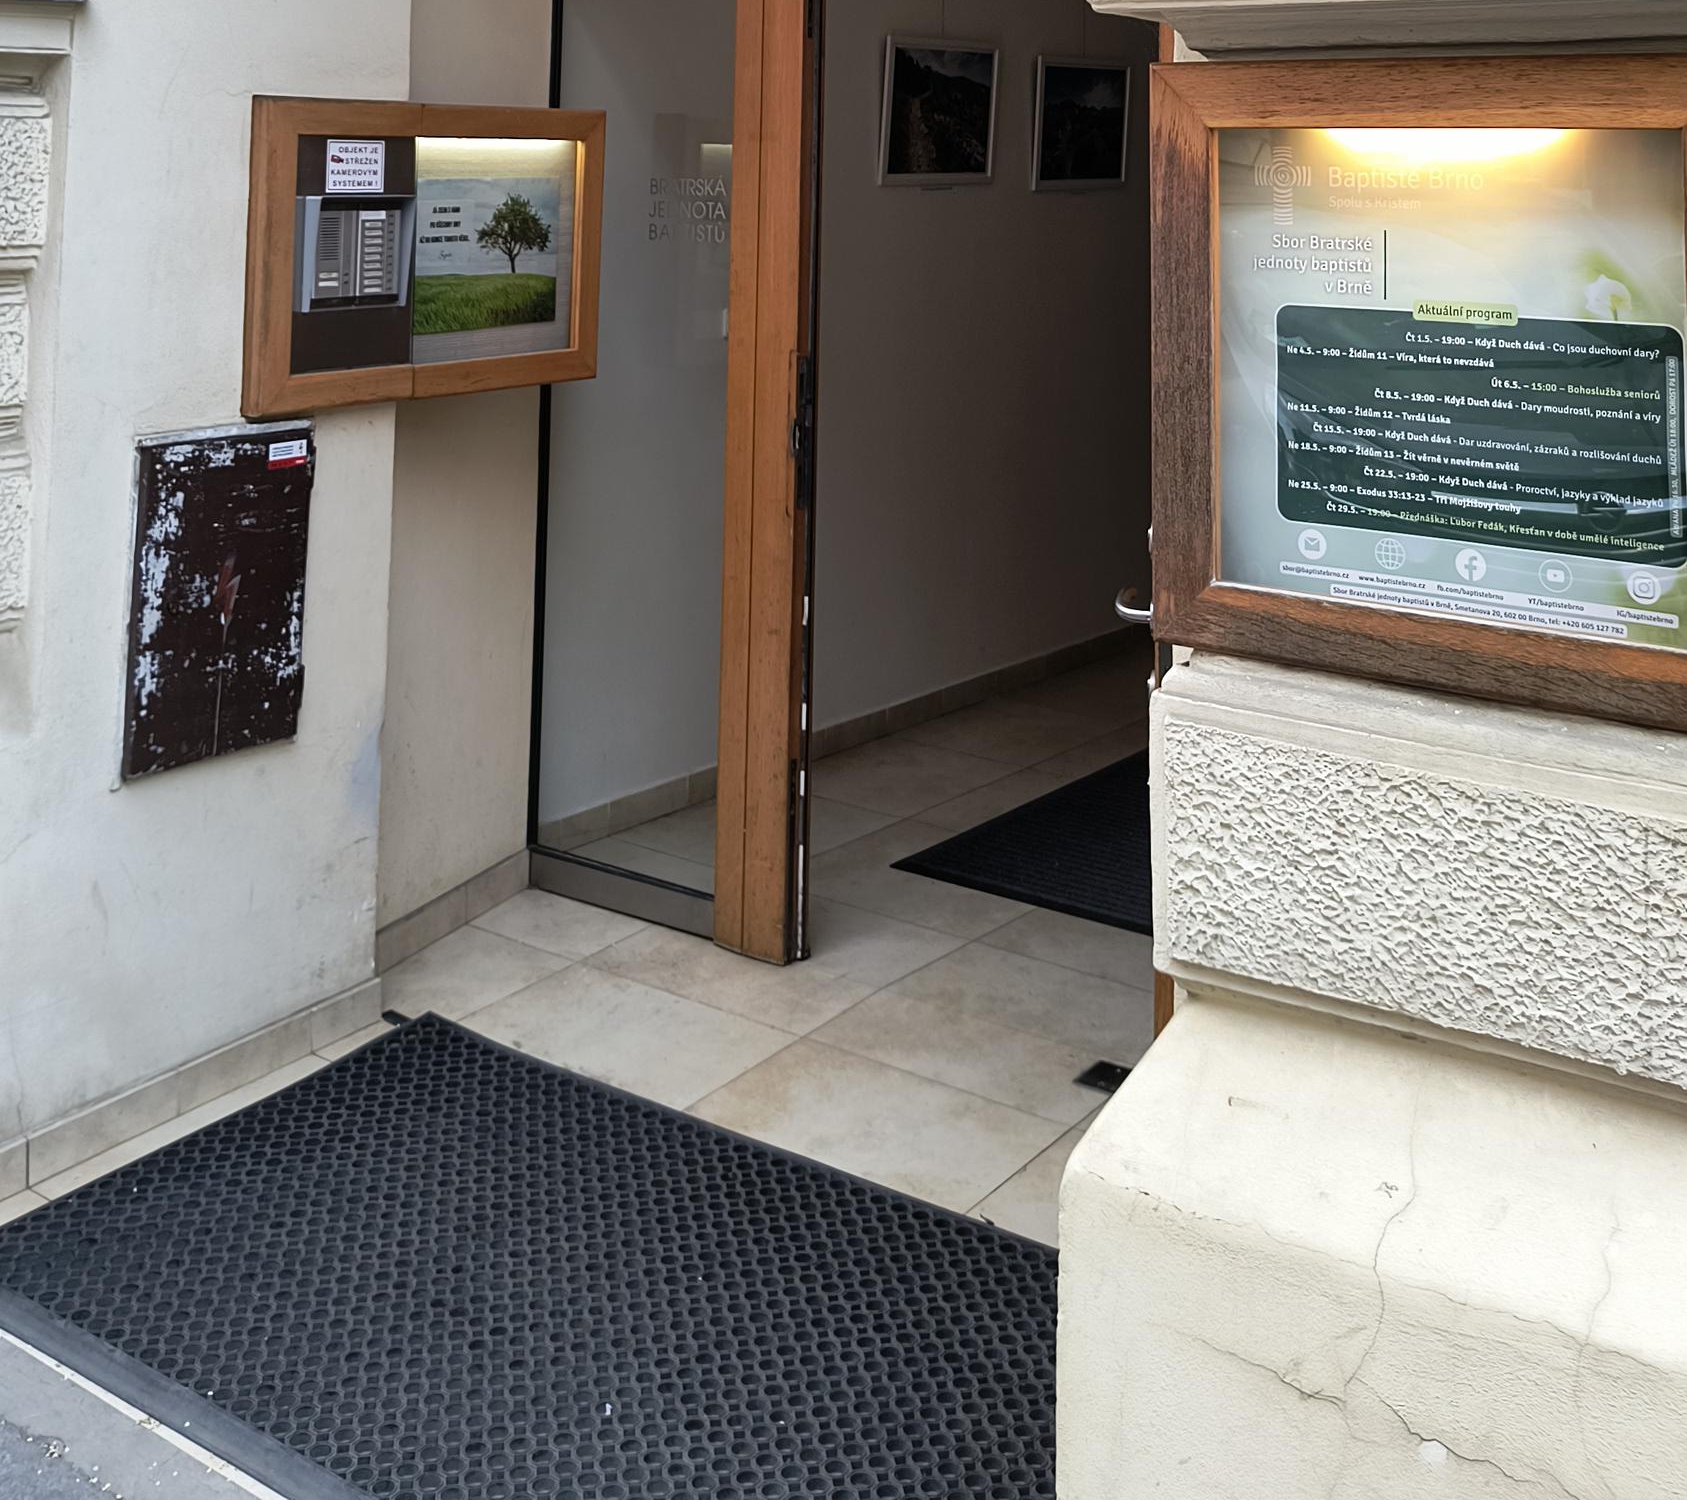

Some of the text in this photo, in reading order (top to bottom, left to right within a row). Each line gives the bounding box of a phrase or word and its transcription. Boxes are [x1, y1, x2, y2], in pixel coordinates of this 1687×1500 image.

[338, 146, 379, 154] OBJEKT JE
[1430, 167, 1484, 191] Brno
[648, 200, 726, 219] JENOTA
[648, 221, 726, 243] BAISTŮ
[1272, 233, 1373, 252] Sbor Bratrské
[1253, 255, 1372, 275] jednoty baptistů
[1325, 279, 1373, 295] v Brně
[1417, 305, 1513, 320] Aktuální program
[1287, 345, 1298, 354] Ne
[1322, 348, 1340, 357] 9:00
[1348, 347, 1375, 359] Židům
[1377, 351, 1387, 360] 11
[1396, 352, 1417, 364] Víra,
[1418, 354, 1441, 363] která
[1442, 356, 1452, 364] to
[1453, 357, 1494, 367] nevzdává
[1405, 331, 1660, 359] Čt 1.5. 19:00 Když Duch dává Co jsou duchovní dary?
[1491, 377, 1660, 400] Út 6.5. 15:00 Bohoslužba seniorů
[1287, 402, 1451, 424] Ne 11.5. 9:00 Židům 12 Tvrdá láska
[1374, 387, 1385, 399] Čt
[1386, 390, 1402, 400] 8.5.
[1410, 393, 1435, 403] 19:00
[1444, 395, 1466, 407] Když
[1467, 397, 1490, 407] Duch
[1491, 399, 1513, 410] dává
[1521, 402, 1542, 414] Dary
[1543, 405, 1594, 417] moudrosti,
[1595, 410, 1633, 419] poznání
[1642, 411, 1661, 424] víry
[1313, 421, 1323, 432] Čt
[1324, 425, 1345, 435] 15.5.
[1352, 427, 1376, 437] 19:00
[1385, 430, 1406, 441] Když
[1407, 432, 1429, 442] Duch
[1430, 434, 1451, 444] dává
[1459, 437, 1475, 446] Dar
[1476, 440, 1532, 453] uzdravování,
[1534, 444, 1569, 455] zázraků
[1579, 450, 1630, 461] rozlišování
[1632, 454, 1662, 464] duchů
[1288, 440, 1299, 450] Ne
[1300, 442, 1321, 452] 18.5.
[1329, 445, 1347, 454] 9:00
[1355, 444, 1382, 457] Židům
[1384, 450, 1394, 459] 13
[1403, 449, 1416, 461] Žít
[1417, 453, 1442, 464] věrně
[1450, 457, 1494, 469] nevěrném
[1495, 461, 1520, 471] světě
[1363, 465, 1373, 476] Čt
[1375, 468, 1396, 478] 22.5.
[1405, 472, 1430, 482] 19:00
[1439, 475, 1460, 486] Když
[1462, 478, 1485, 488] Duch
[1486, 480, 1508, 490] dává
[1516, 483, 1559, 497] Proroctví,
[1561, 489, 1591, 502] jazyky
[1288, 479, 1299, 488] Ne
[1300, 481, 1321, 491] 25.5.
[1330, 484, 1348, 493] 9:00
[1356, 486, 1386, 497] Exodus
[1388, 490, 1425, 502] 33:13-23
[1495, 500, 1521, 514] touhy
[1326, 501, 1336, 511] Čt
[1338, 503, 1358, 514] 29.5.
[1400, 510, 1448, 523] Přednáška:
[1478, 520, 1507, 533] Fedák,
[1509, 525, 1545, 536] Křesťan
[1554, 530, 1577, 540] době
[1579, 535, 1608, 544] umělé
[1611, 534, 1664, 551] inteligence
